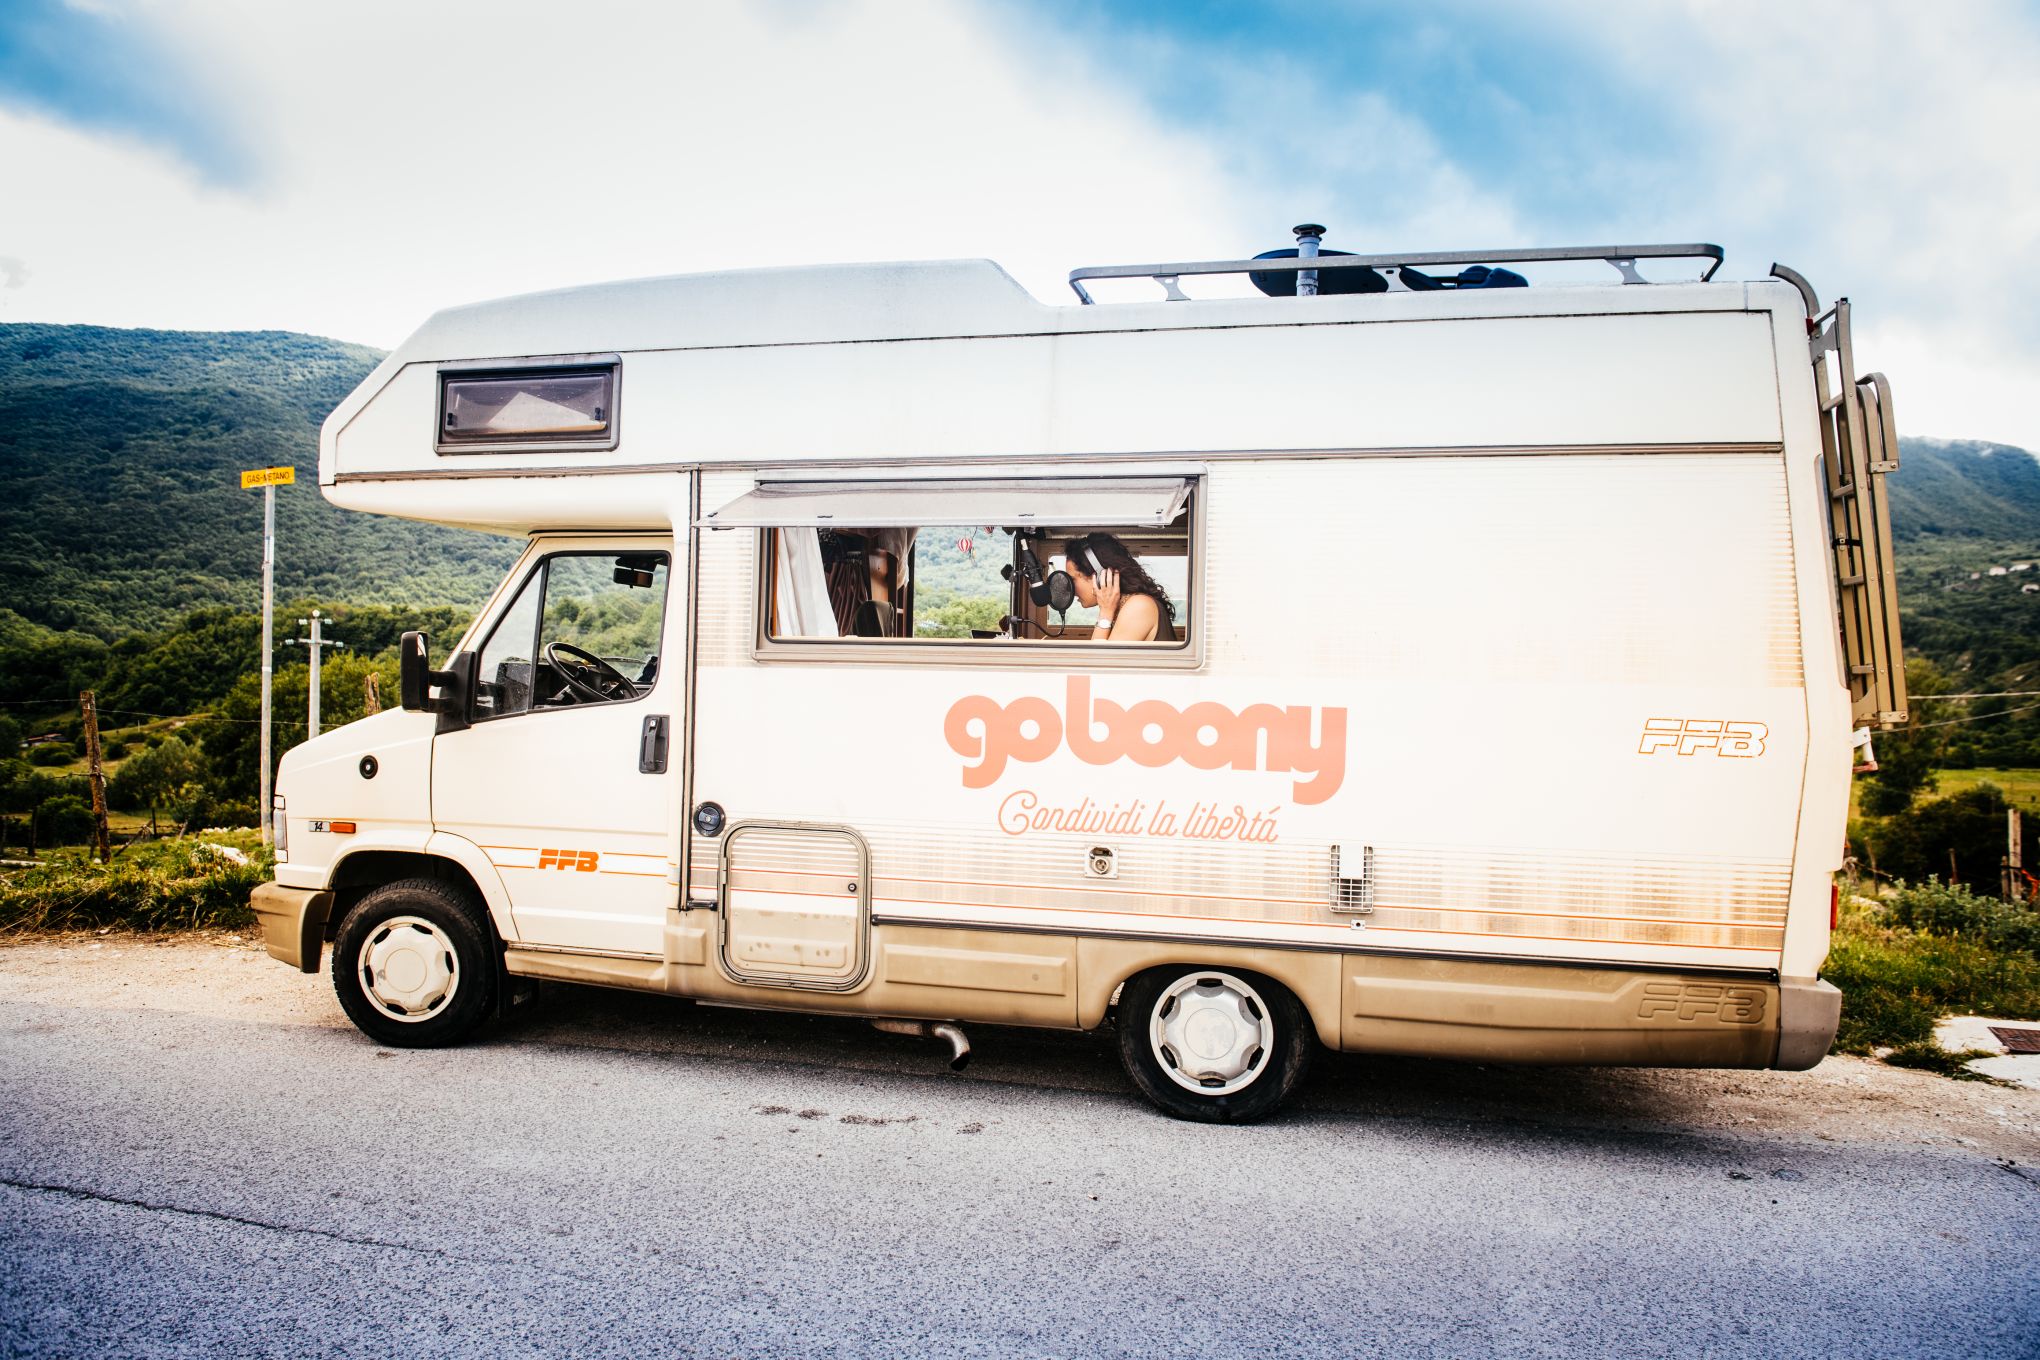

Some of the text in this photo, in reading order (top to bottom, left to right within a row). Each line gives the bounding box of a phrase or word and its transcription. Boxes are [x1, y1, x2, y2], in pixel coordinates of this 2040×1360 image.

[943, 675, 1348, 806] goboony
[1637, 717, 1769, 759] FFB
[314, 821, 323, 832] 14
[997, 789, 1143, 836] Condividi
[1147, 799, 1179, 837] la
[537, 848, 600, 873] FFB
[1637, 982, 1768, 1025] FFB
